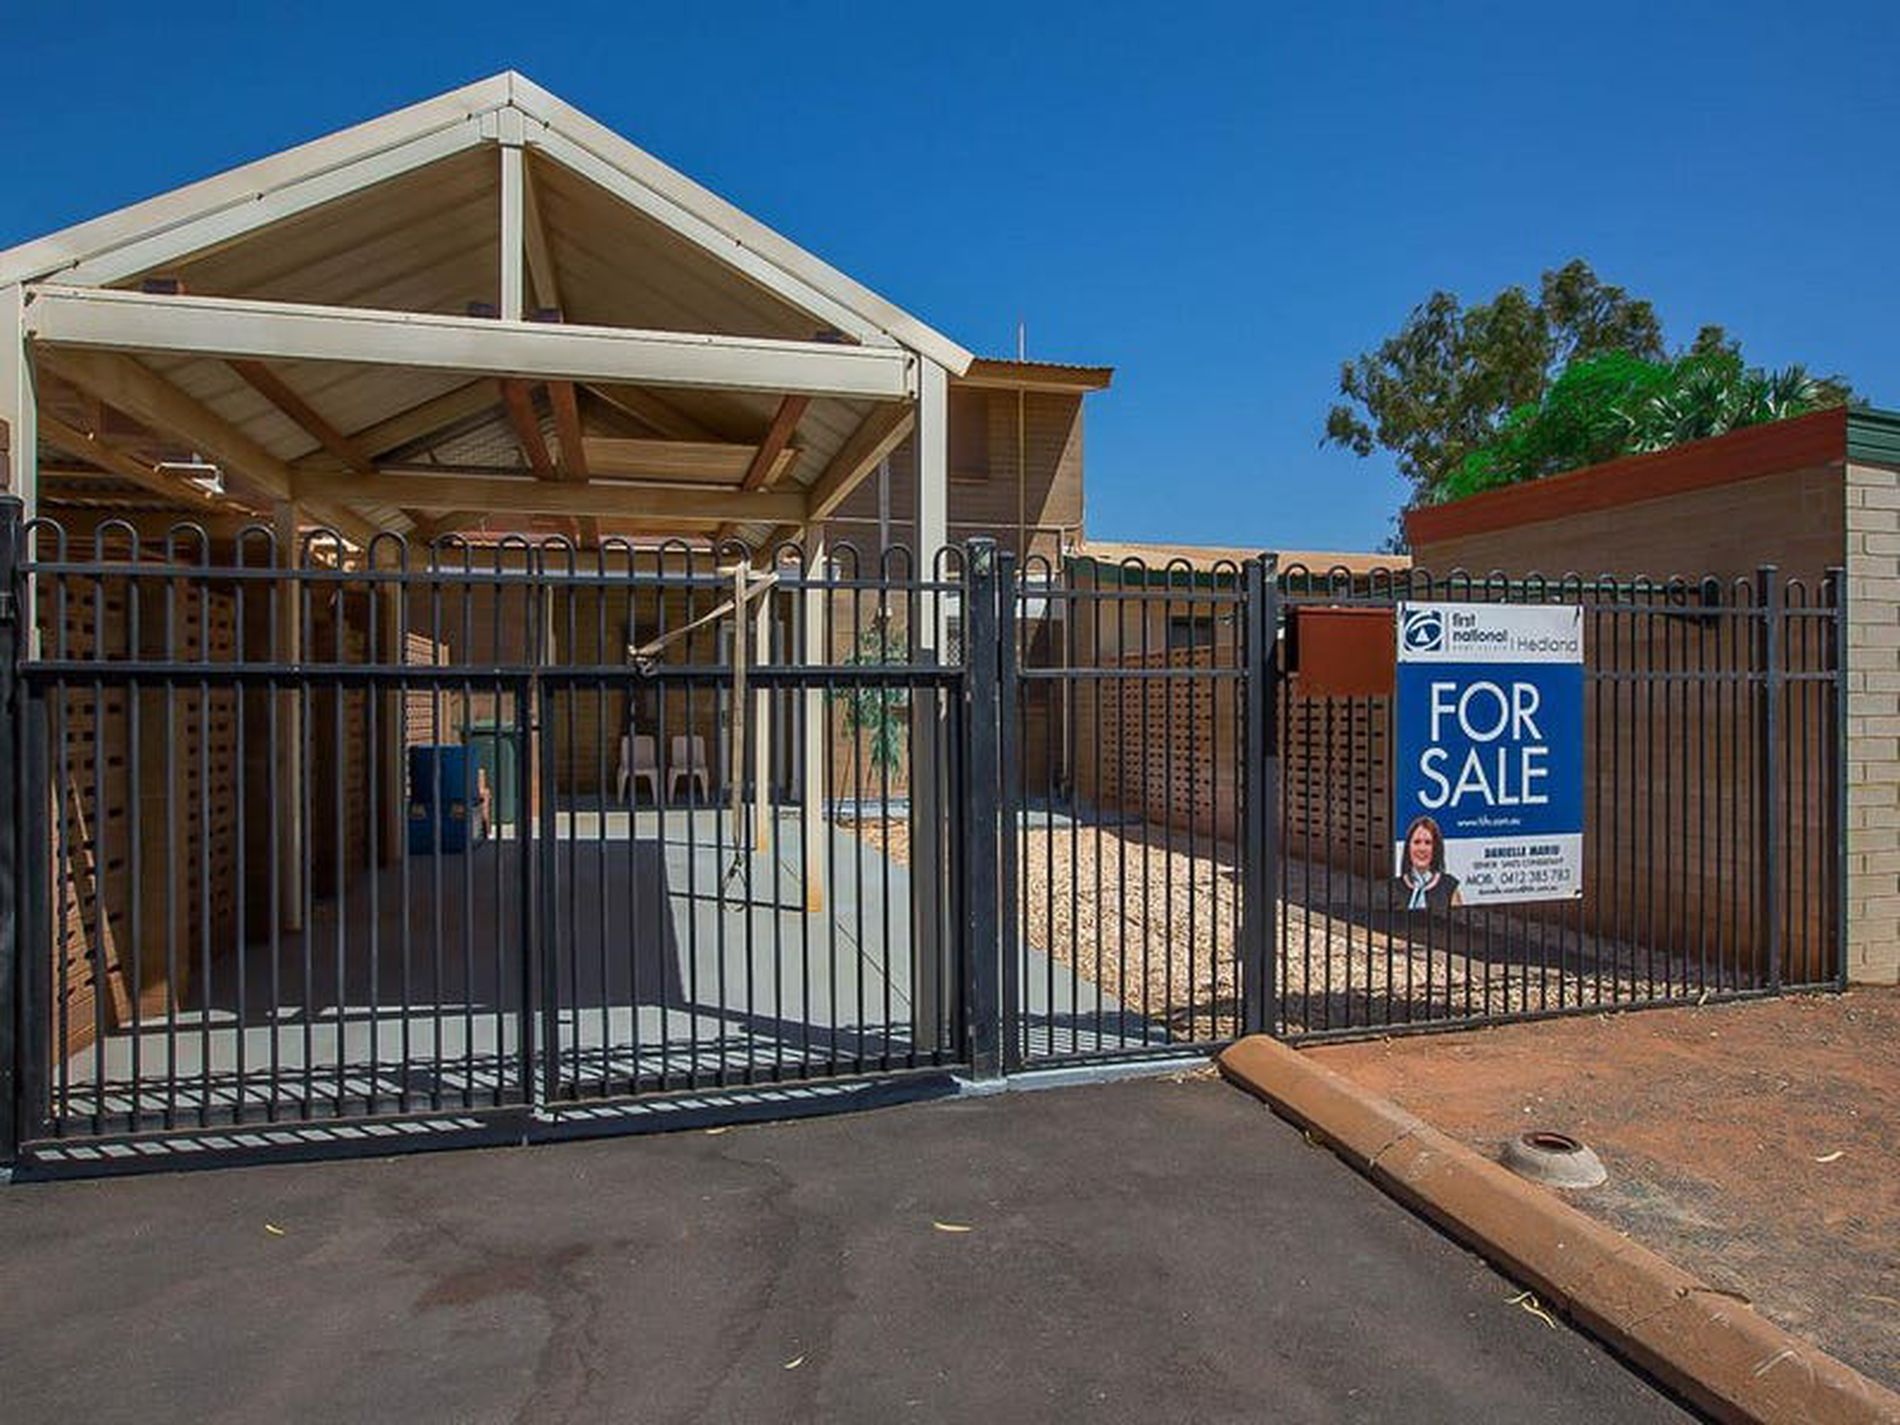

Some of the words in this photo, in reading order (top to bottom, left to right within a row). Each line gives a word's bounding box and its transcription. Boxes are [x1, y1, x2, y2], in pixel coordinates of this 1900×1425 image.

[1452, 612, 1476, 628] first
[1452, 629, 1508, 643] national
[1517, 637, 1578, 652] Hedland
[1431, 681, 1542, 742] FOR
[1417, 747, 1548, 808] SALE
